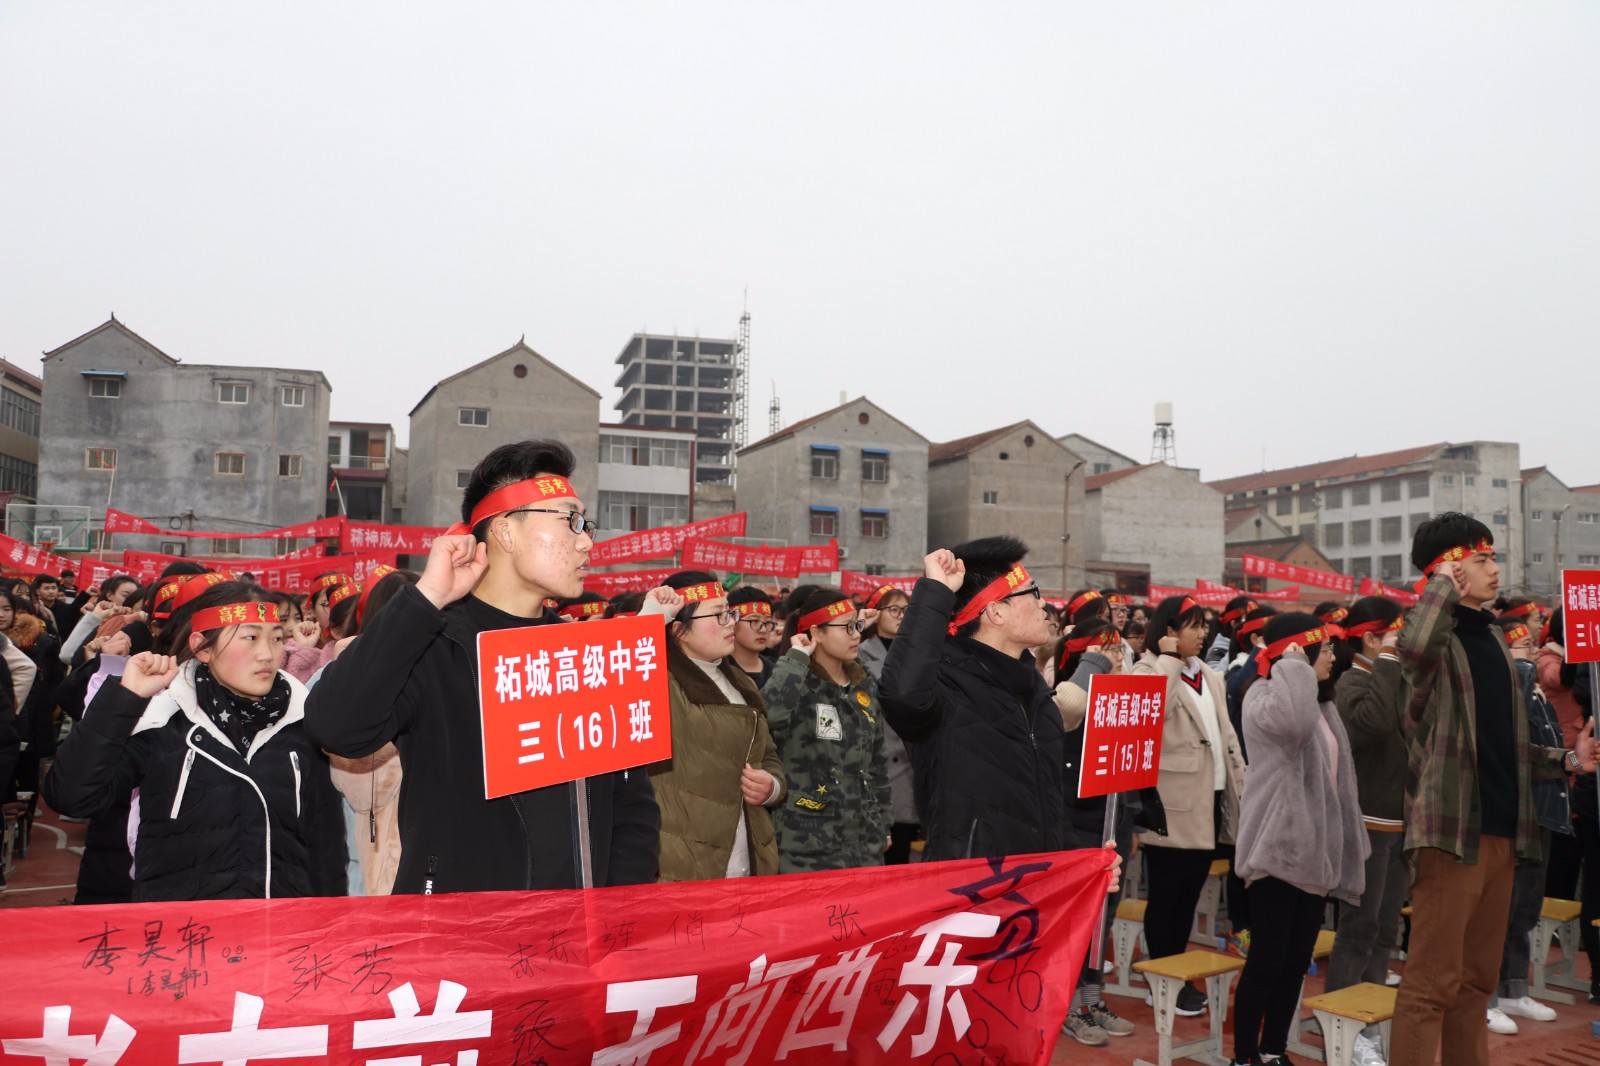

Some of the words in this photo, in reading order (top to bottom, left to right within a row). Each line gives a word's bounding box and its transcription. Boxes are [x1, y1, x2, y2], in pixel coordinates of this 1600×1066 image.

[535, 477, 567, 496] 高考
[205, 573, 227, 585] 高考
[321, 574, 337, 586] 高考
[1005, 566, 1025, 588] 高考
[160, 584, 179, 599] 高考
[334, 585, 350, 601] 高考
[684, 585, 708, 601] 高考
[219, 604, 248, 623] 高考
[583, 603, 599, 614] 高考
[827, 602, 846, 616] 高考
[1305, 630, 1323, 642] 高考
[494, 636, 657, 703] 柘城高级中学
[1094, 692, 1161, 728] 柘城高级中学
